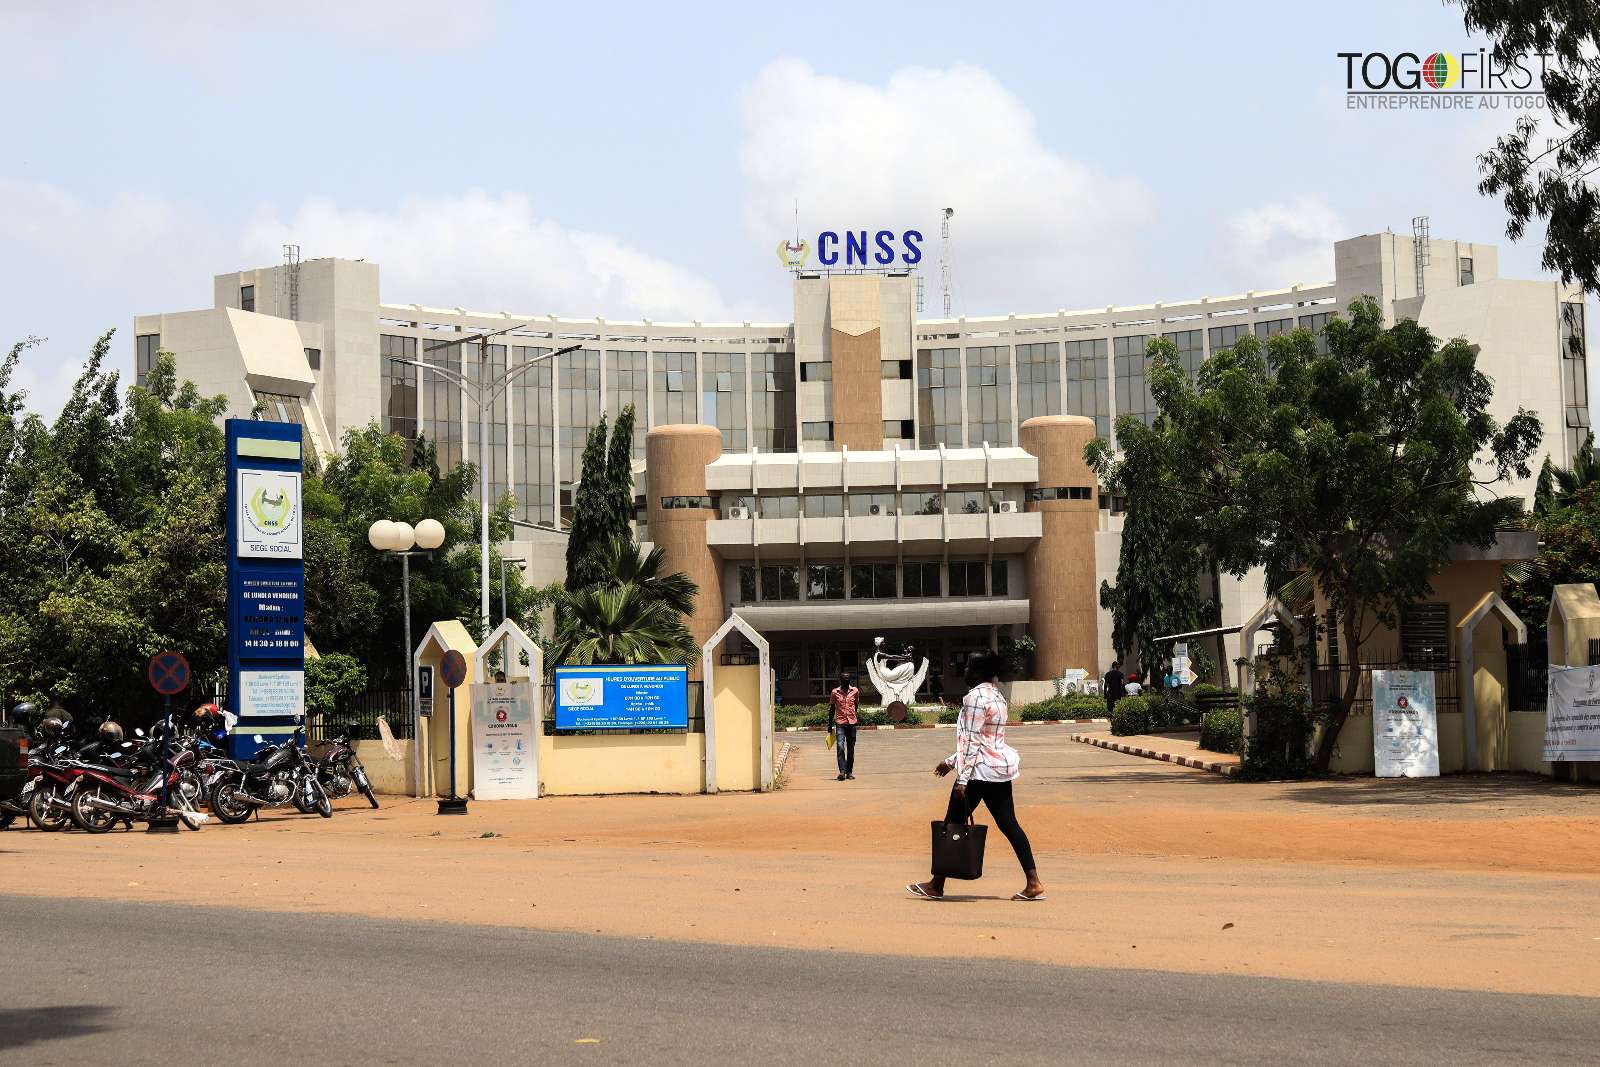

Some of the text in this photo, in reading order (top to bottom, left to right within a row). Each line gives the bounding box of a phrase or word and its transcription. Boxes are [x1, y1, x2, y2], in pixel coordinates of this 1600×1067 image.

[818, 230, 923, 265] CNSS
[250, 544, 292, 553] SIEGE SOCIAL
[272, 592, 298, 600] VENDREDI
[258, 603, 281, 611] Matin
[290, 640, 299, 648] 00
